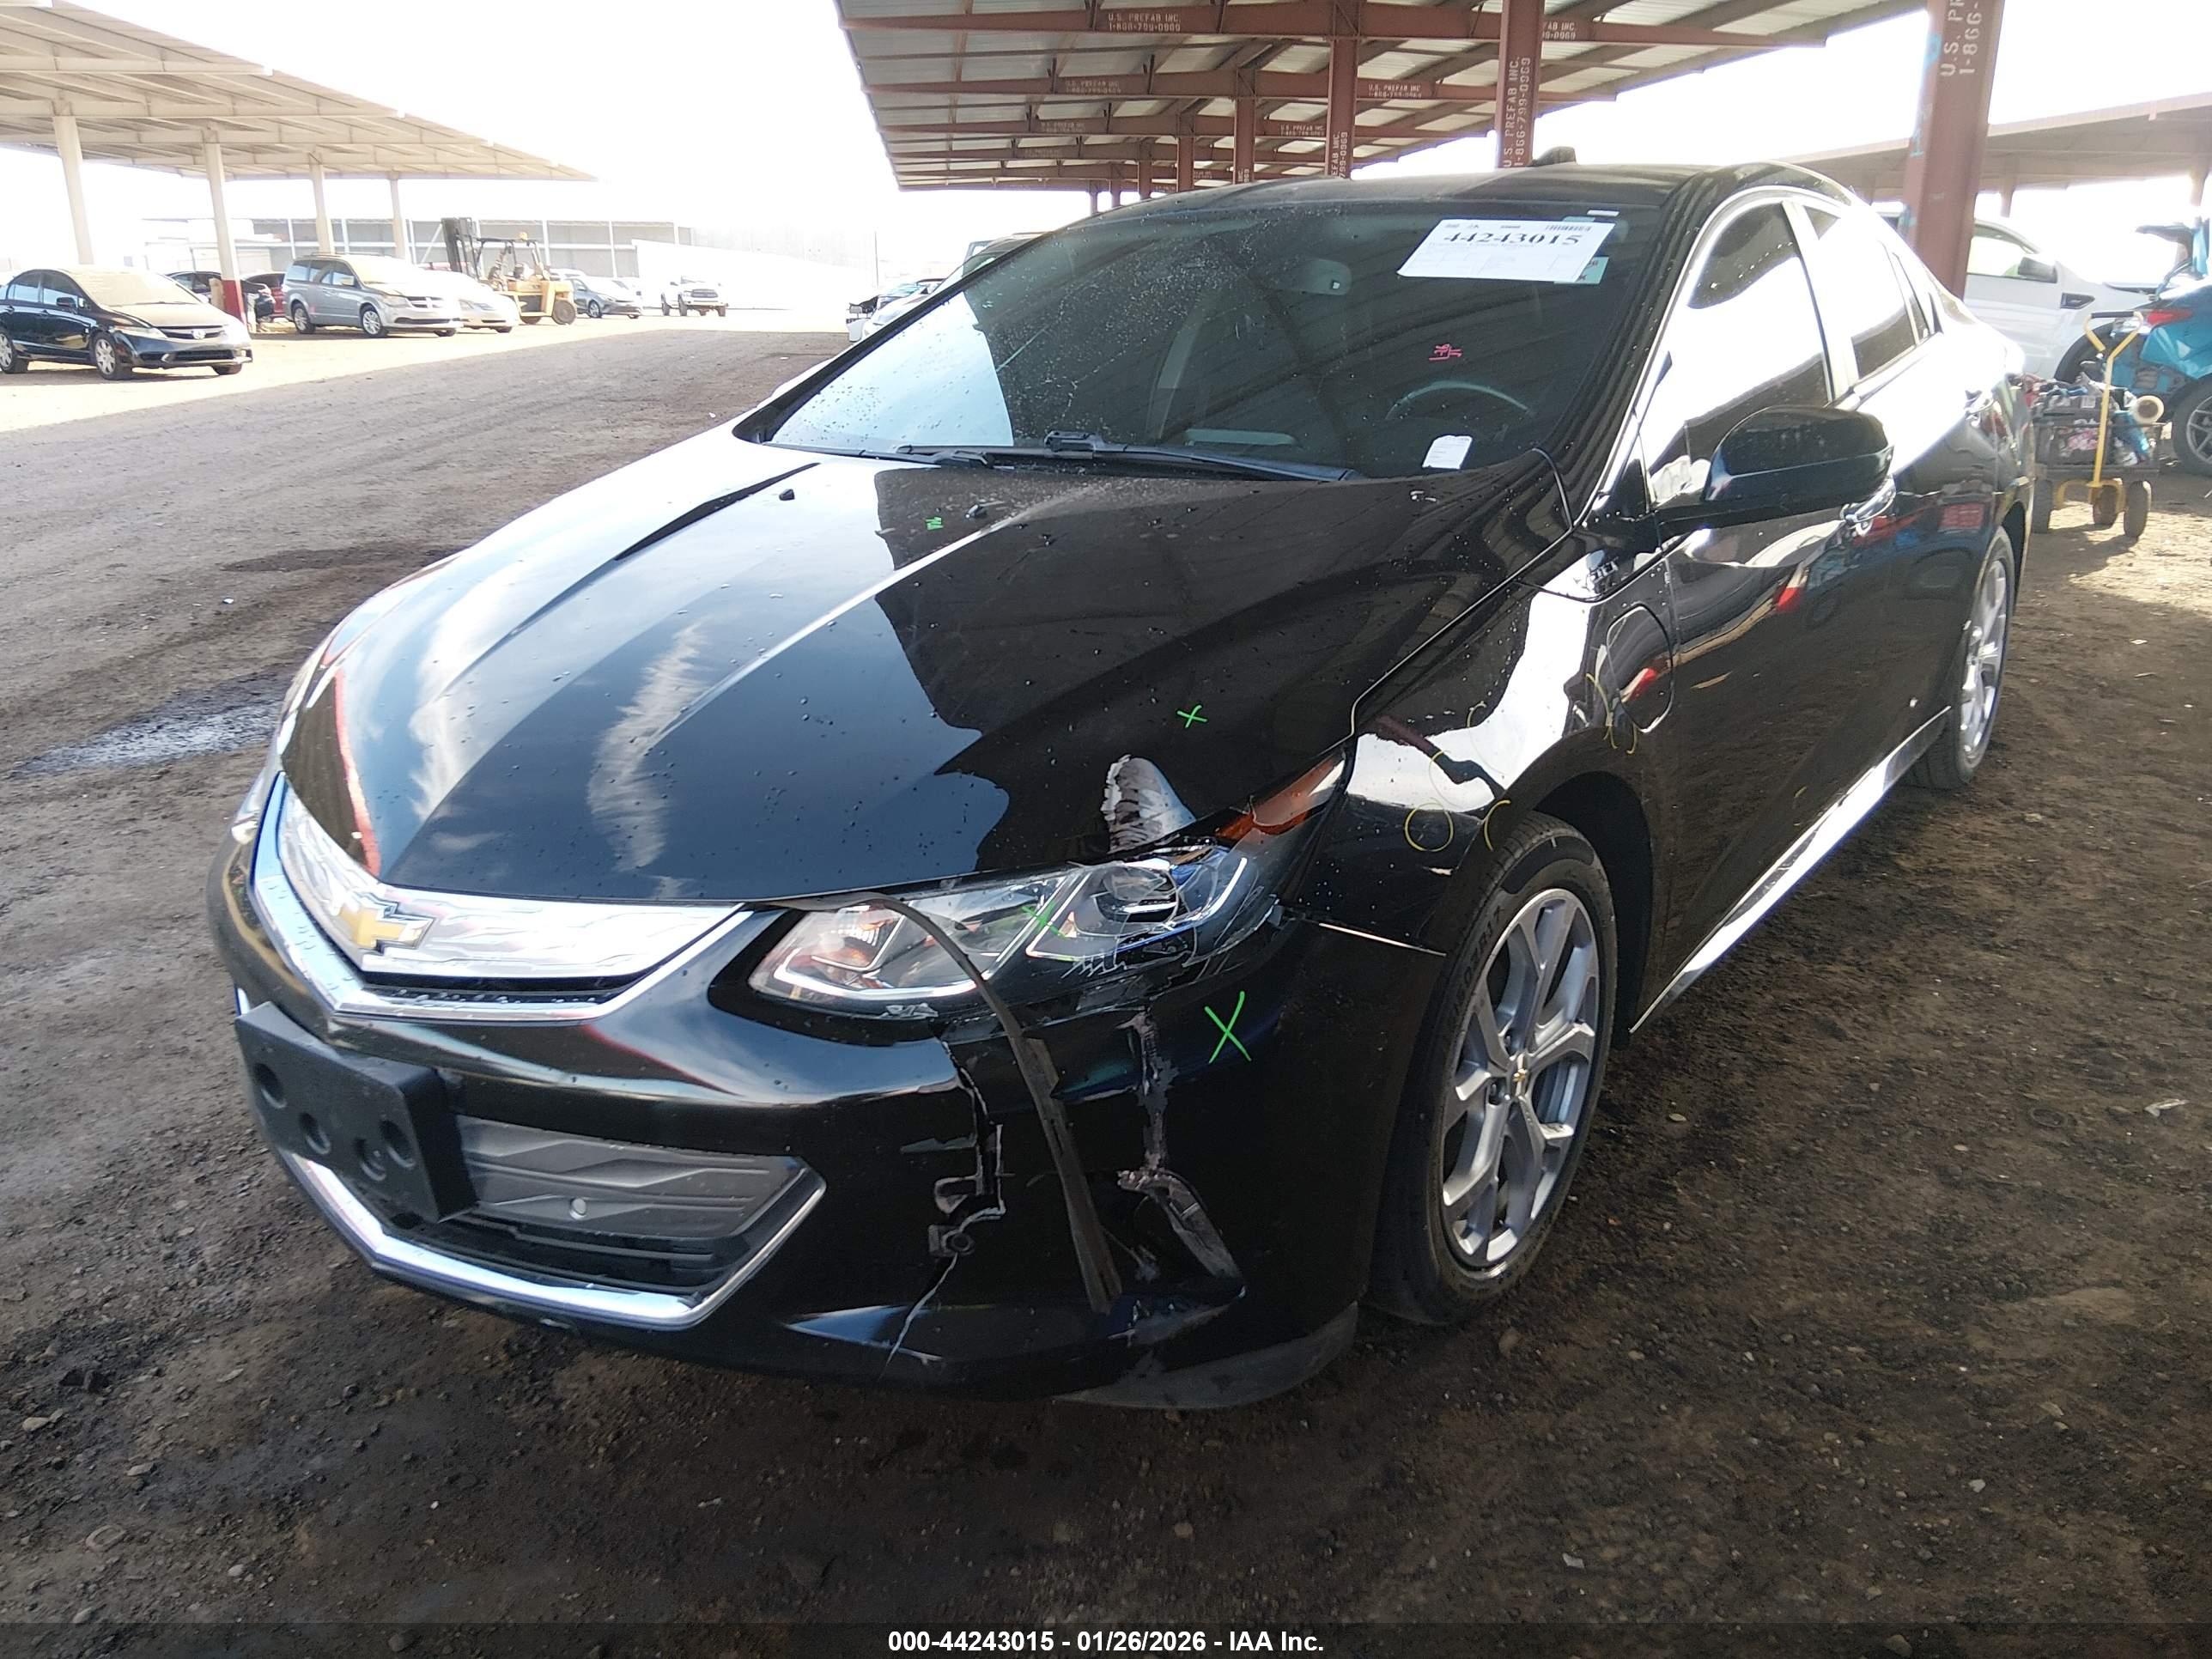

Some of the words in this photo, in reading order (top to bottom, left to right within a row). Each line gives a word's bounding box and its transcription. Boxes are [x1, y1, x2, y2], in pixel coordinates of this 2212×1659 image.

[1509, 57, 1520, 82] INC.
[1504, 88, 1517, 137] PREFAB
[1514, 58, 1530, 166] 1-866-799-0969
[1443, 232, 1583, 246] 44243015
